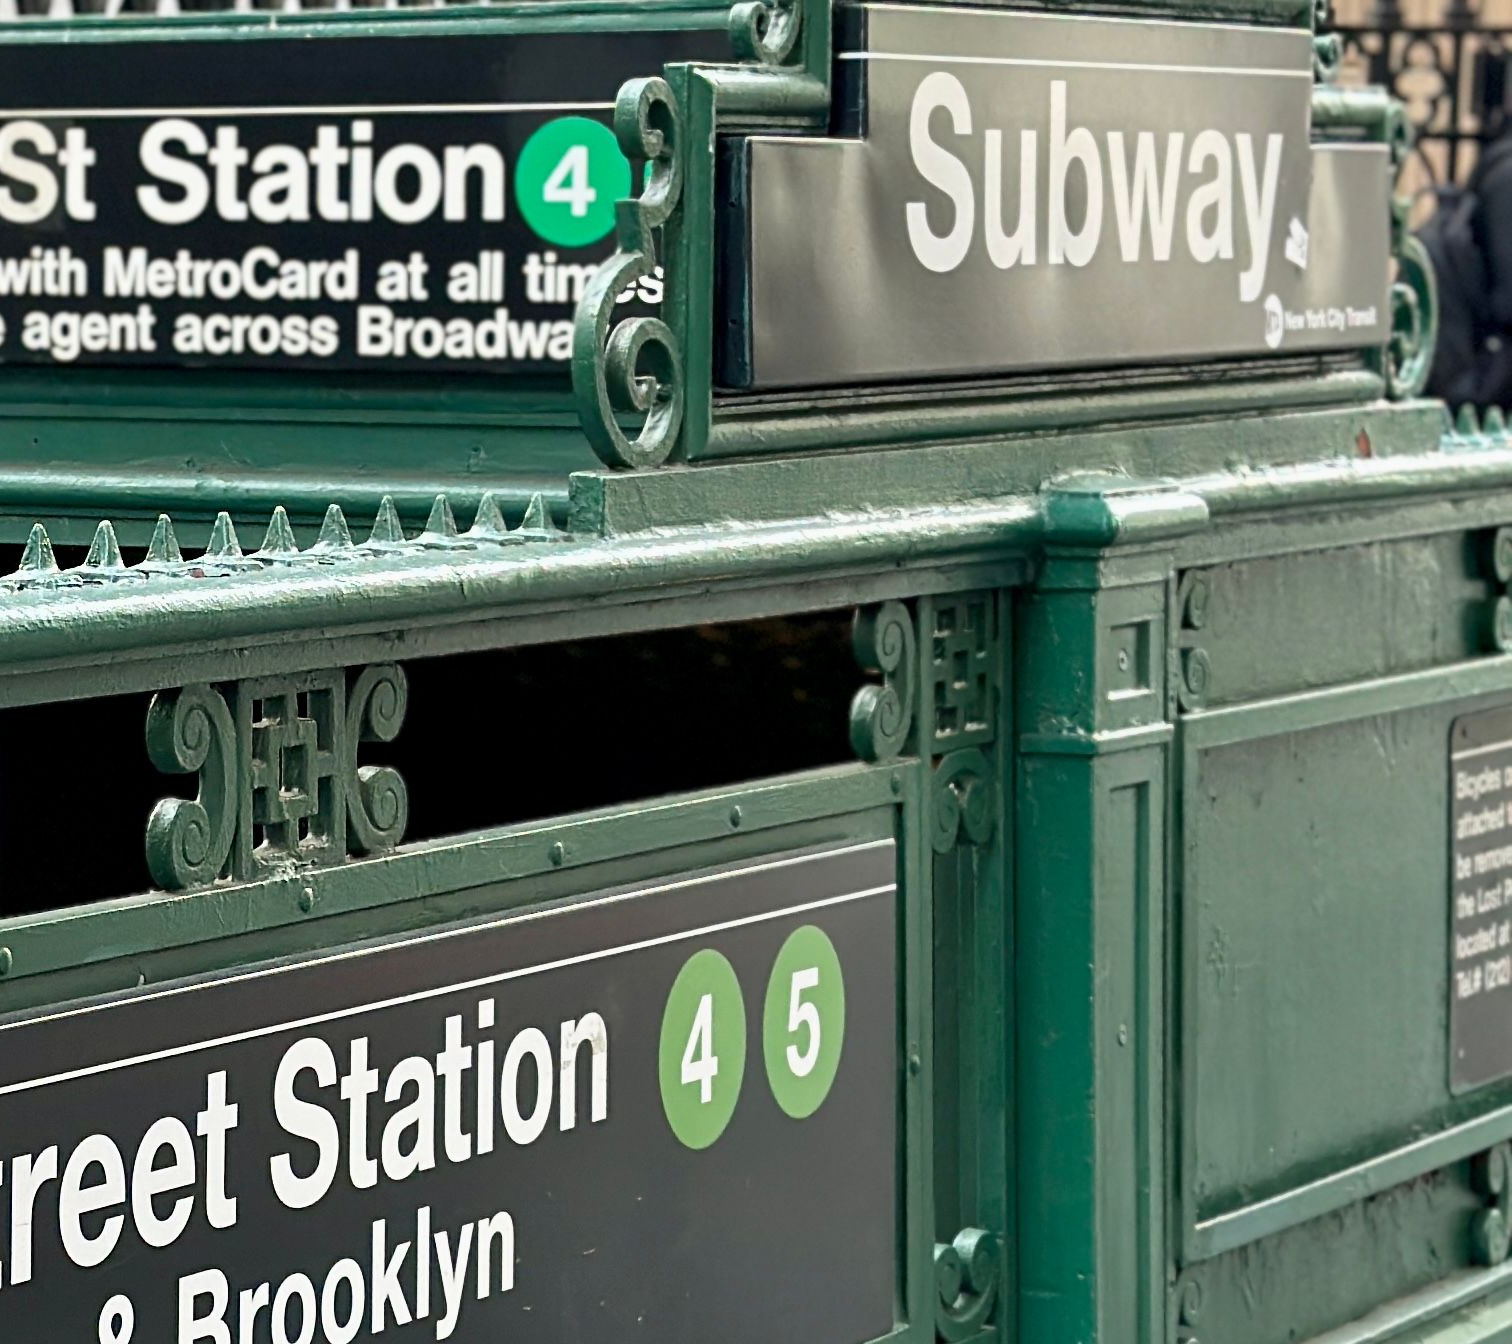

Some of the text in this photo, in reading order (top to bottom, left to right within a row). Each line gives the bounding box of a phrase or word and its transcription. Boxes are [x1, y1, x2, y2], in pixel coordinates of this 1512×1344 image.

[136, 118, 506, 223] Station
[543, 145, 597, 217] 4
[905, 71, 1284, 304] Subway
[103, 246, 359, 301] MetroCard
[376, 253, 429, 301] at
[447, 251, 504, 302] all
[21, 305, 156, 361] agent
[173, 313, 339, 355] across
[357, 306, 575, 360] Broadwa
[1306, 308, 1326, 329] York
[1328, 307, 1345, 332] City
[269, 998, 610, 1208] Station
[680, 993, 719, 1104] 4
[786, 966, 821, 1078] 5
